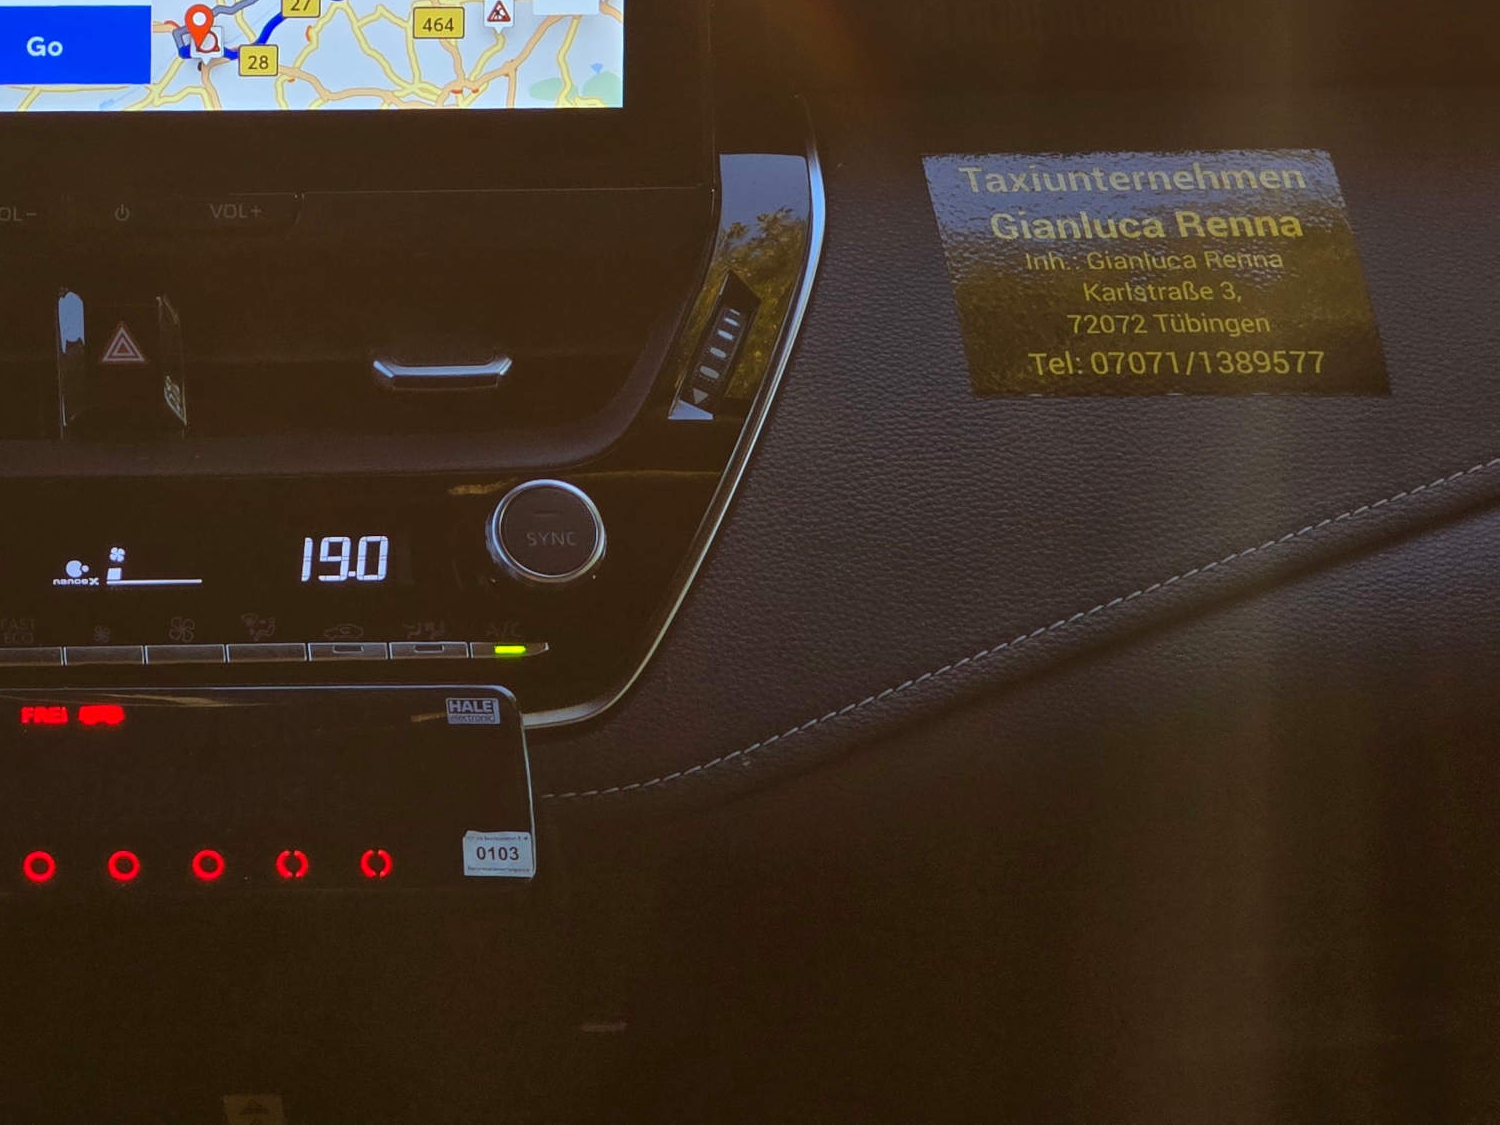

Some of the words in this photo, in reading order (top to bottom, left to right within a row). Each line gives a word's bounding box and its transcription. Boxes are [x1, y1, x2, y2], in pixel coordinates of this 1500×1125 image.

[422, 17, 455, 33] 464
[26, 37, 63, 58] Go
[247, 55, 269, 70] 28
[959, 162, 1307, 194] Taxiunternehmen
[990, 212, 1166, 240] Gianluca
[1176, 210, 1303, 238] Renna
[1086, 251, 1197, 271] Gianluca
[1204, 250, 1284, 270] Renna
[1083, 282, 1213, 302] Karlstraße
[1221, 281, 1242, 303] 3,
[1067, 315, 1149, 334] 72072
[1153, 314, 1270, 337] Tübingen
[1028, 352, 1082, 375] Tel:
[1091, 350, 1325, 375] 07071/1389577
[526, 530, 577, 547] SYNC
[302, 535, 389, 583] 19.0
[21, 706, 68, 725] FREI
[449, 699, 493, 713] HALE
[476, 846, 520, 861] 0103
